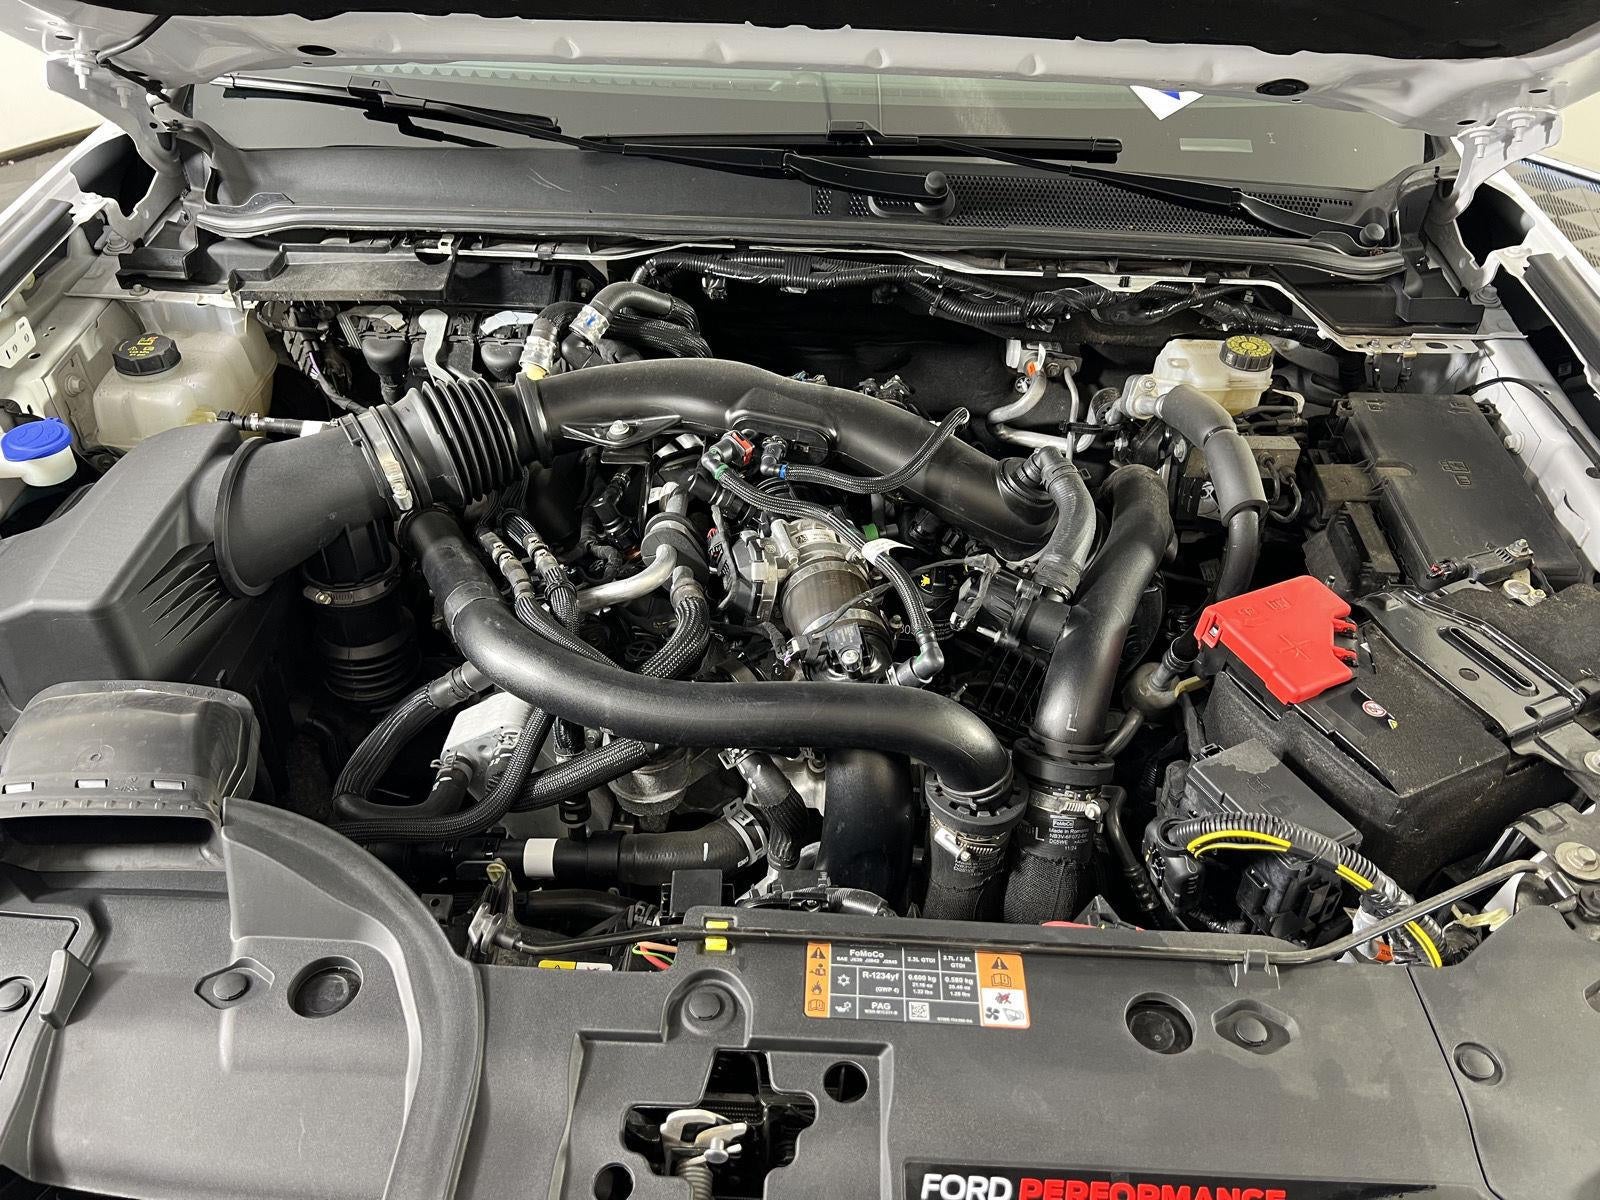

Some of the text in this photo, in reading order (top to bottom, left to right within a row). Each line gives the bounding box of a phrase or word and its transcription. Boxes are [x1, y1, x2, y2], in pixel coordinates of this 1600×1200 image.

[849, 949, 884, 958] FoMoCo
[862, 971, 900, 982] R-1234yf
[927, 975, 937, 983] kg
[964, 977, 974, 986] kg
[871, 1002, 891, 1010] PAG
[921, 1173, 1013, 1200] FORD
